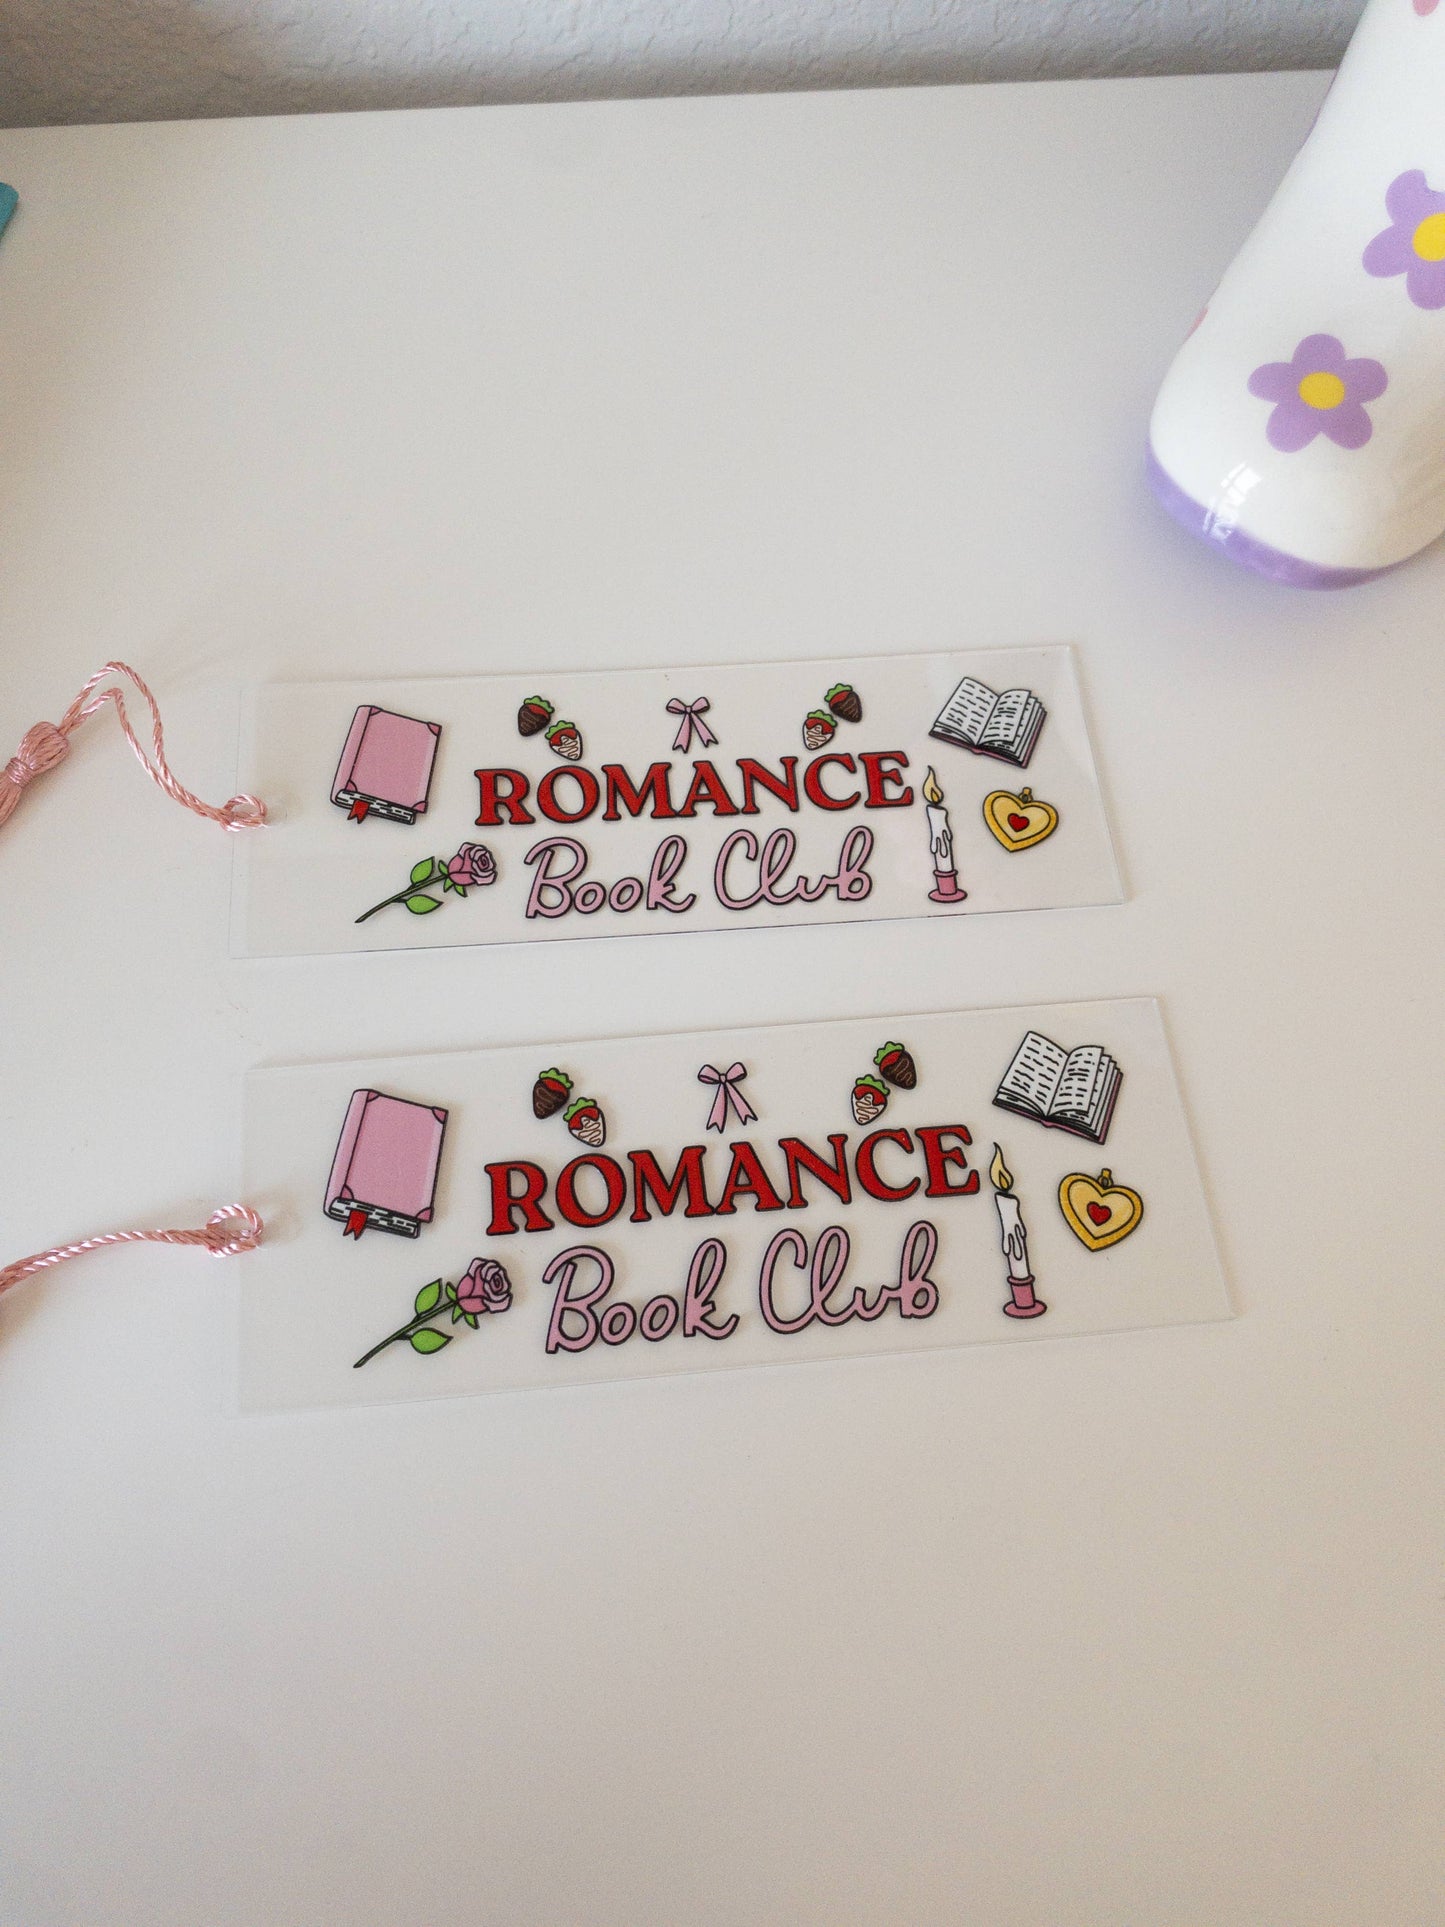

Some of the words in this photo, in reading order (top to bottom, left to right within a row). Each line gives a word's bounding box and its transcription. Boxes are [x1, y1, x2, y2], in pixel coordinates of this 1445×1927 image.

[474, 751, 914, 826] ROMANCE
[524, 835, 697, 919] Book
[714, 825, 874, 910] Club
[484, 1124, 980, 1236] ROMANCE
[542, 1238, 740, 1354] Book
[758, 1220, 940, 1334] Club
